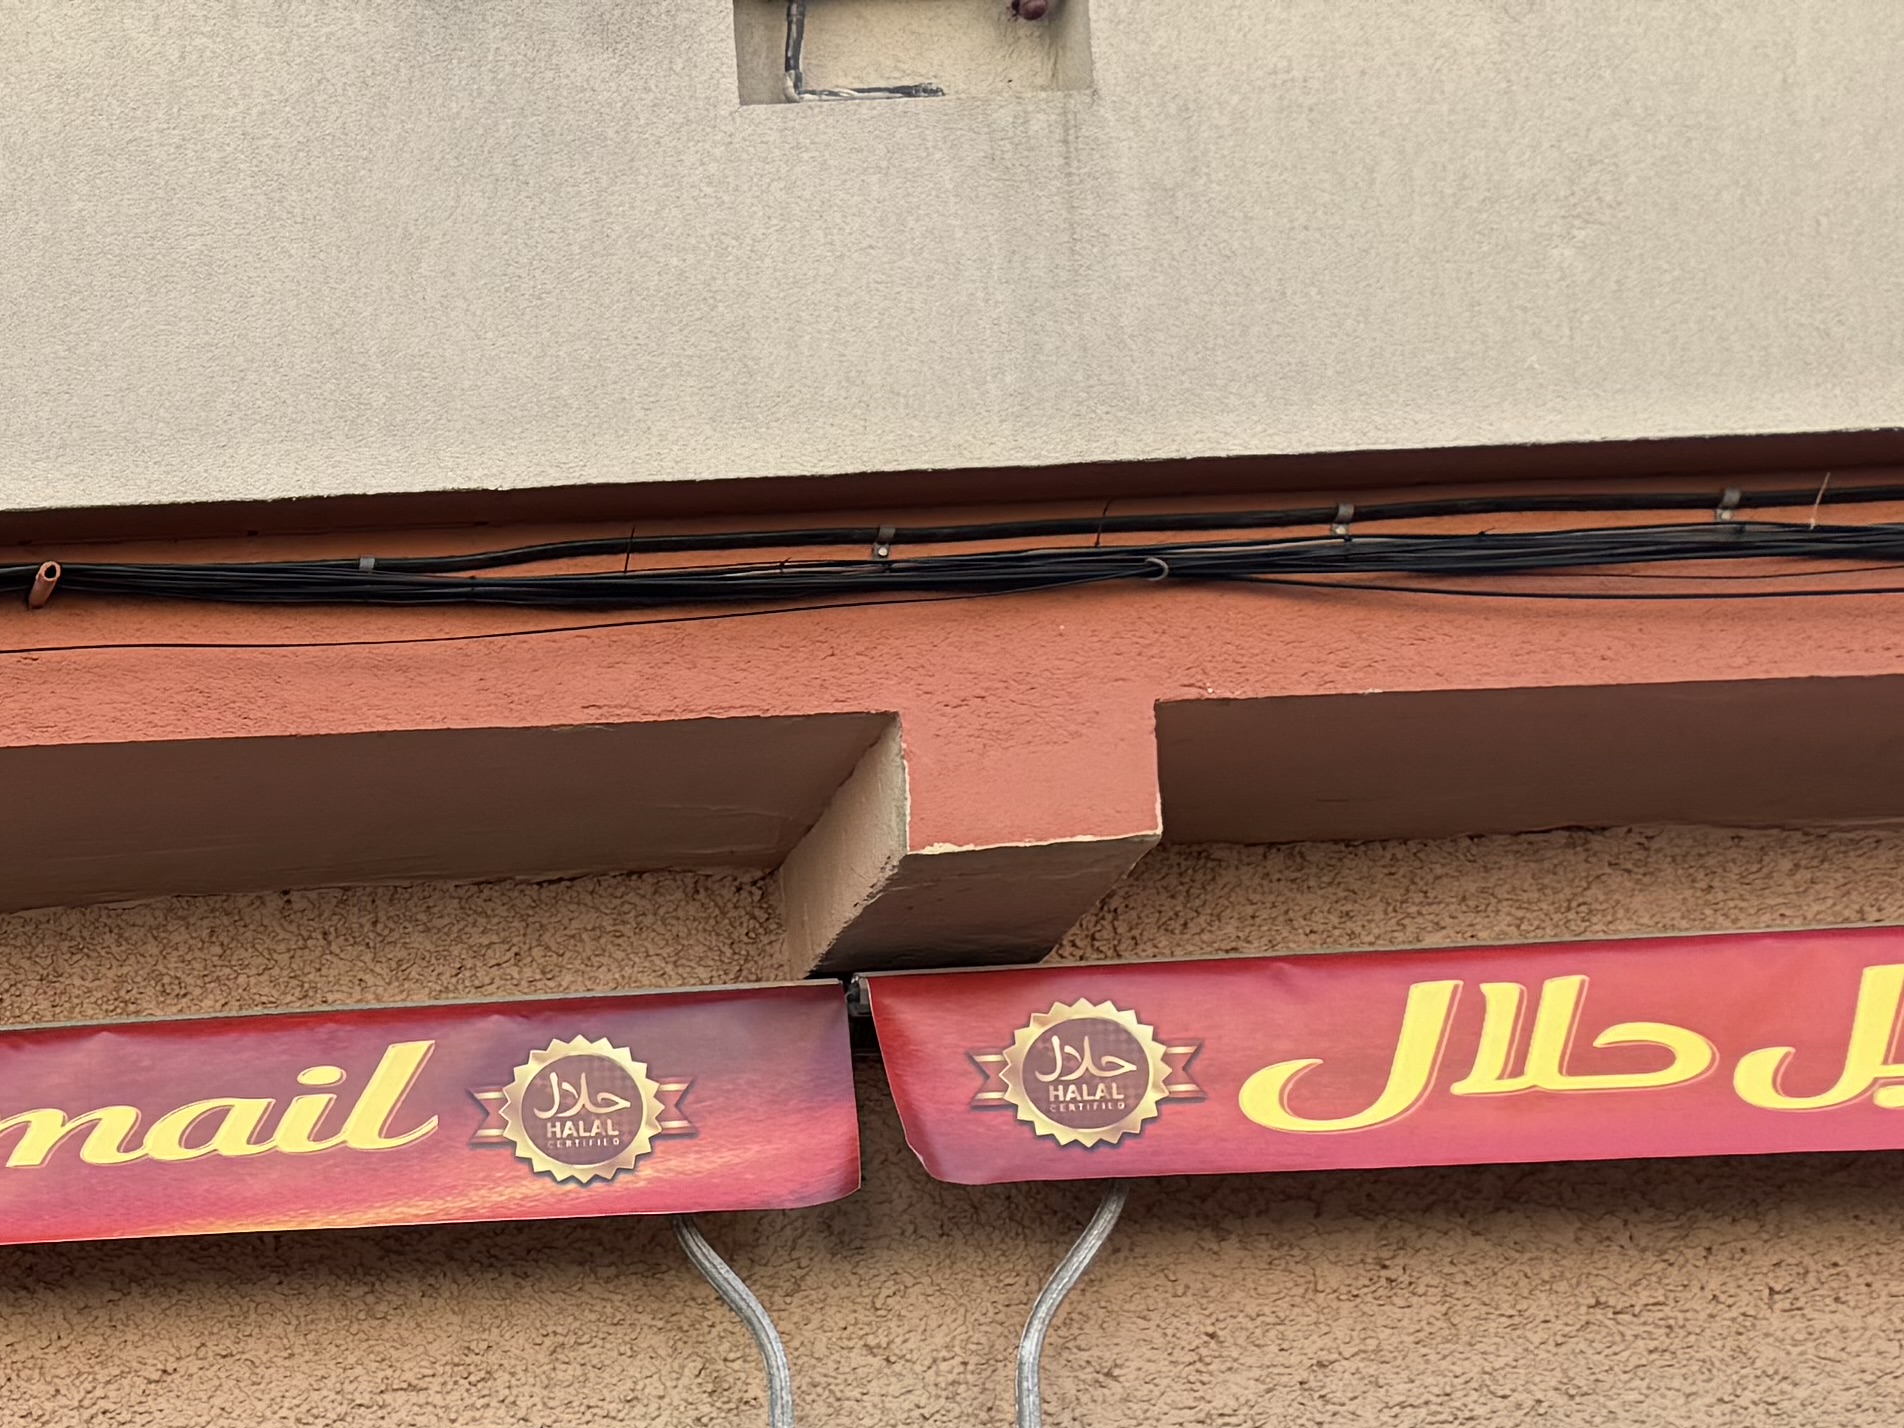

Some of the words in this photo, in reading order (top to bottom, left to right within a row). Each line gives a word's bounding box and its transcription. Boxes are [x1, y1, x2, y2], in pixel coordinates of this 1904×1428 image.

[1035, 1035, 1137, 1082] حلال
[1238, 974, 1720, 1133] حلال
[533, 1072, 631, 1119] حلال
[1048, 1082, 1124, 1102] HALAL
[1049, 1101, 1126, 1113] CERTIFIED
[546, 1118, 619, 1138] HALAL
[547, 1137, 620, 1149] CERTIFIED
